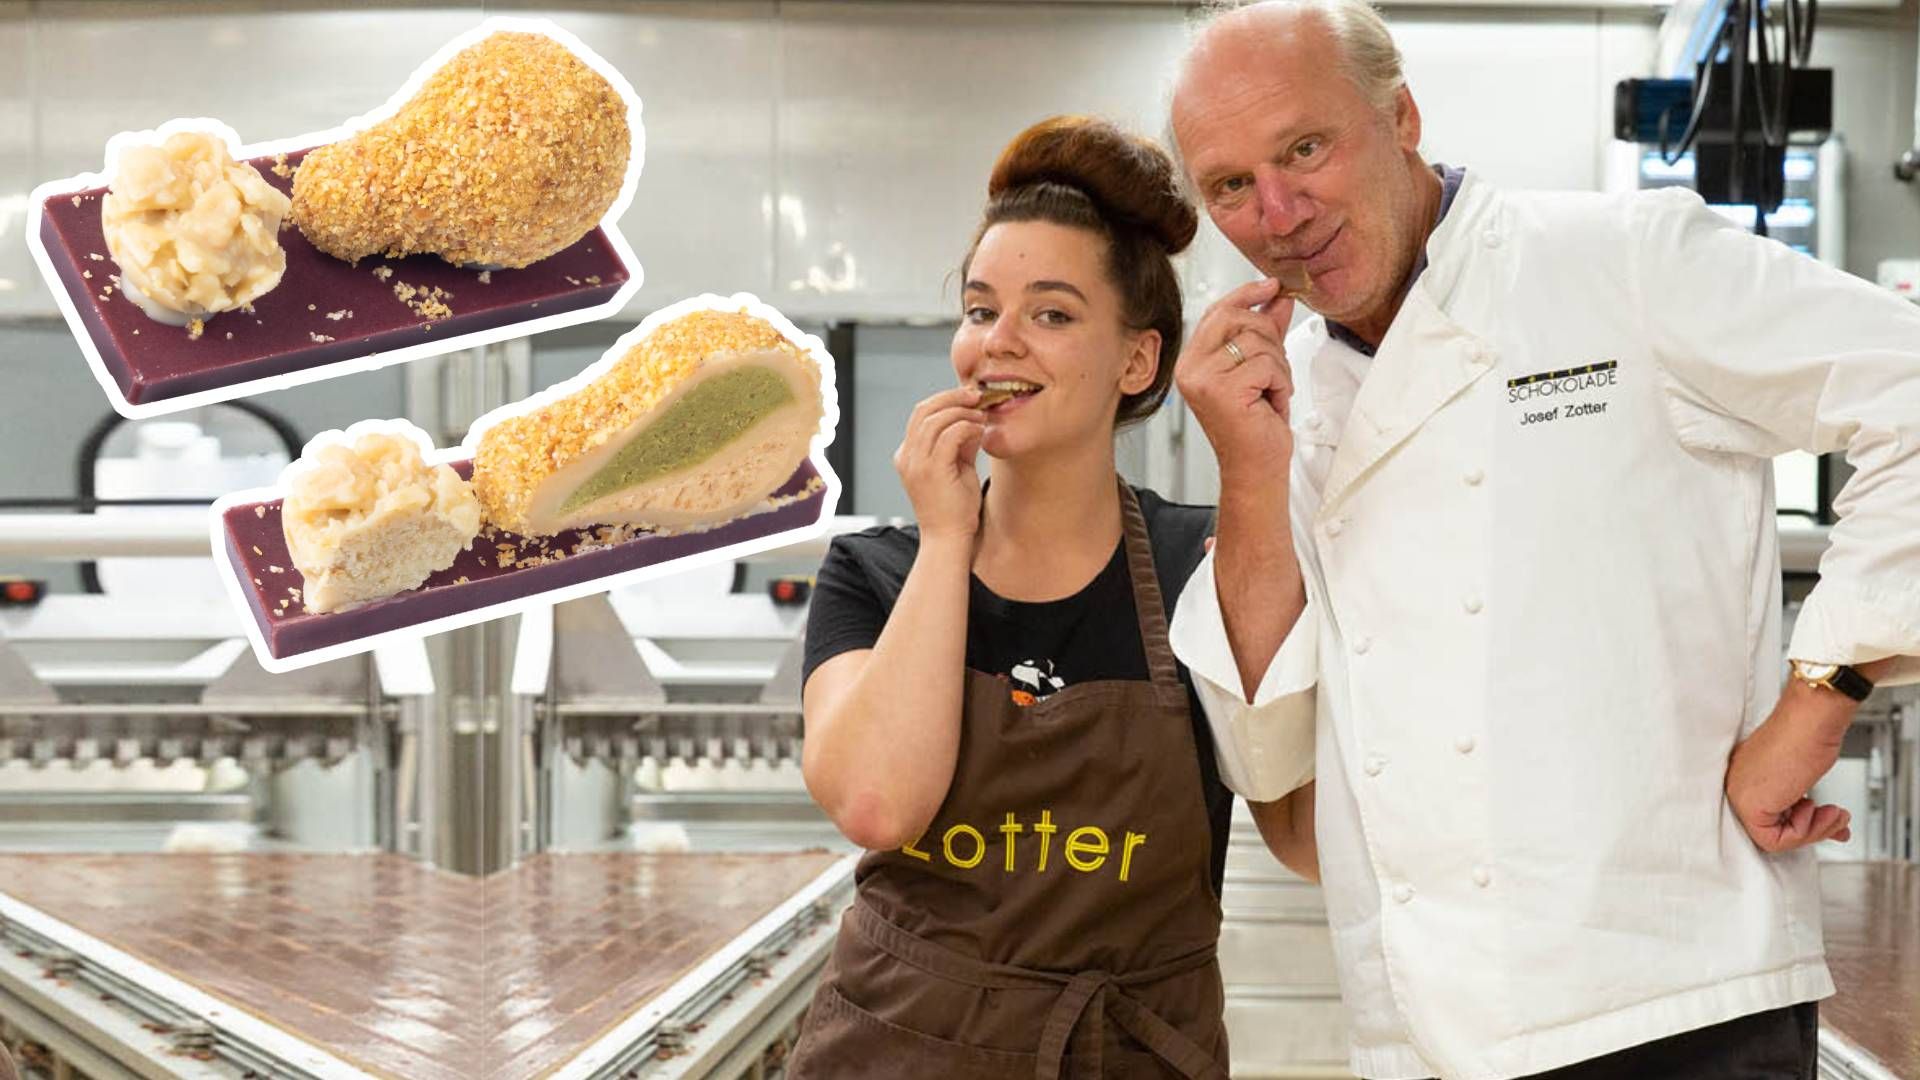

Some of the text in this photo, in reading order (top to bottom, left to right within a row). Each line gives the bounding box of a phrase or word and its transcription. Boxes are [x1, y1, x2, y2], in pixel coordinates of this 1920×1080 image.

[1508, 369, 1617, 403] SCHOKOLADE
[1520, 402, 1608, 425] Josef Zotter
